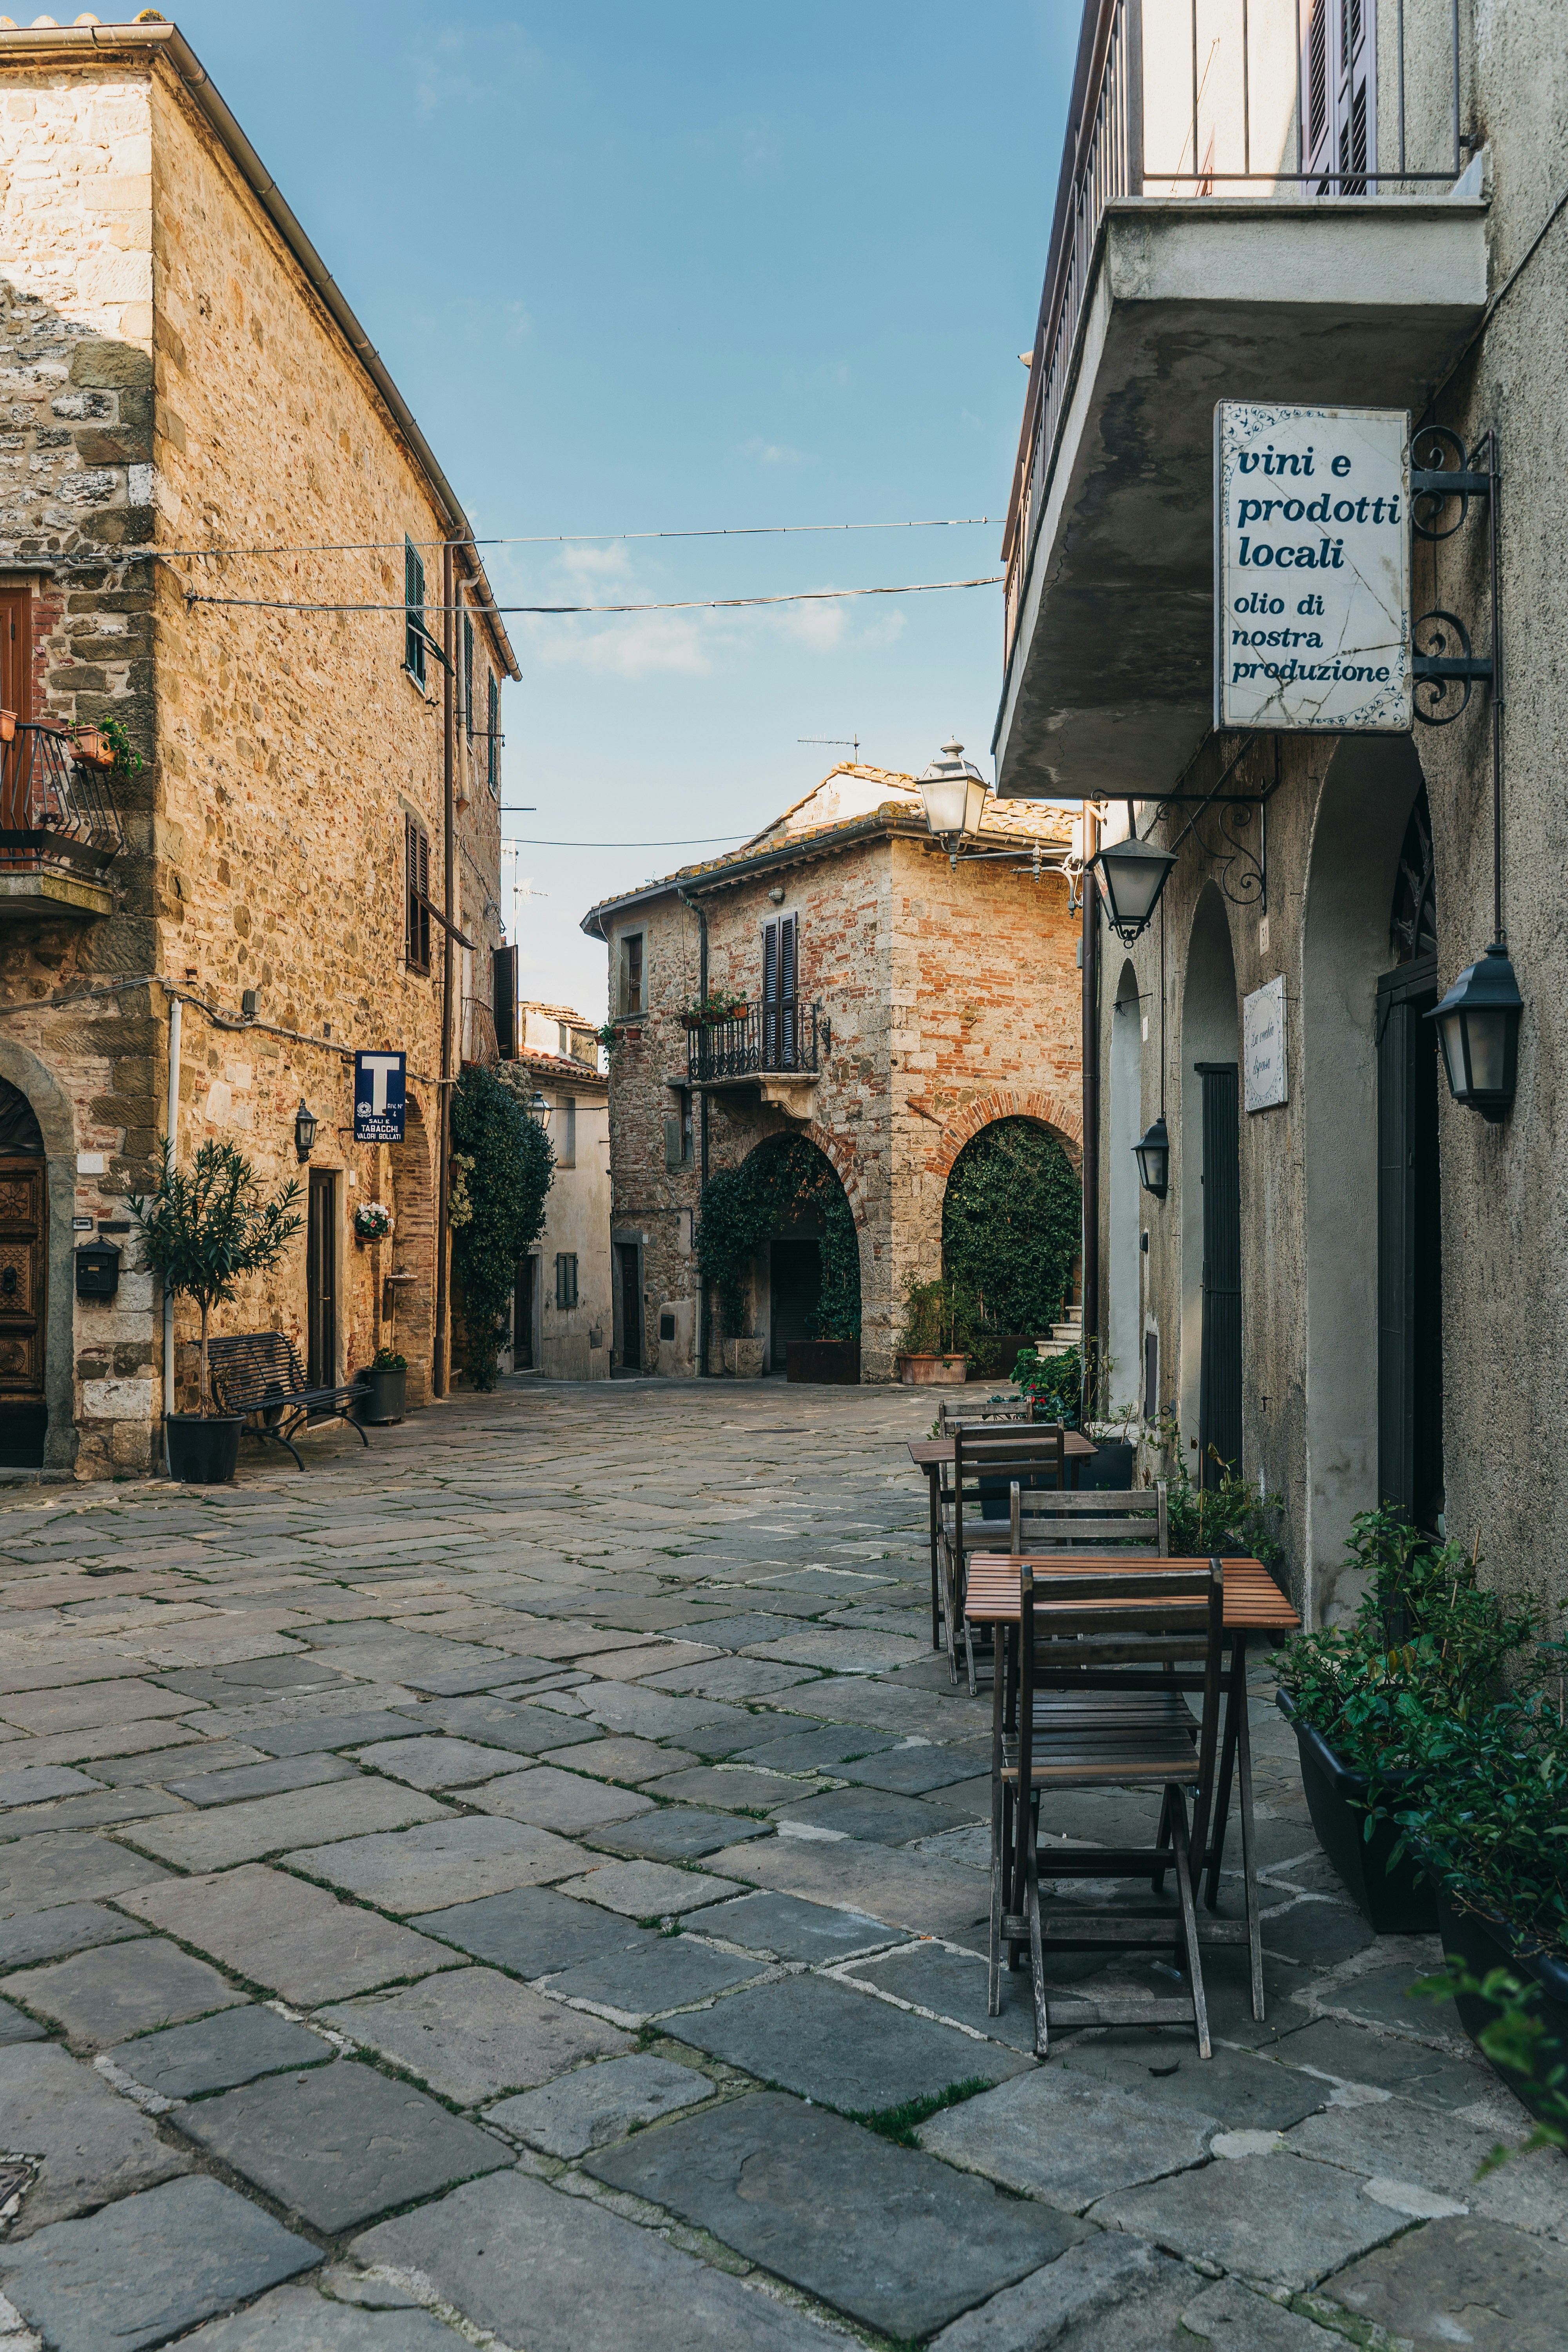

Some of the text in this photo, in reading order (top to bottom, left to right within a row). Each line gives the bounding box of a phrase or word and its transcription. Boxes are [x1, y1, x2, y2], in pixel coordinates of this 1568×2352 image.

[1238, 445, 1351, 477] vini e
[1238, 493, 1401, 528] prodotti
[1239, 537, 1344, 569] locali
[1234, 593, 1325, 616] olio di
[1232, 628, 1323, 648] nostra
[1232, 659, 1390, 683] produzione
[1262, 926, 1267, 947] 31
[1251, 1024, 1258, 1048] La
[1253, 1056, 1270, 1079] dispensa
